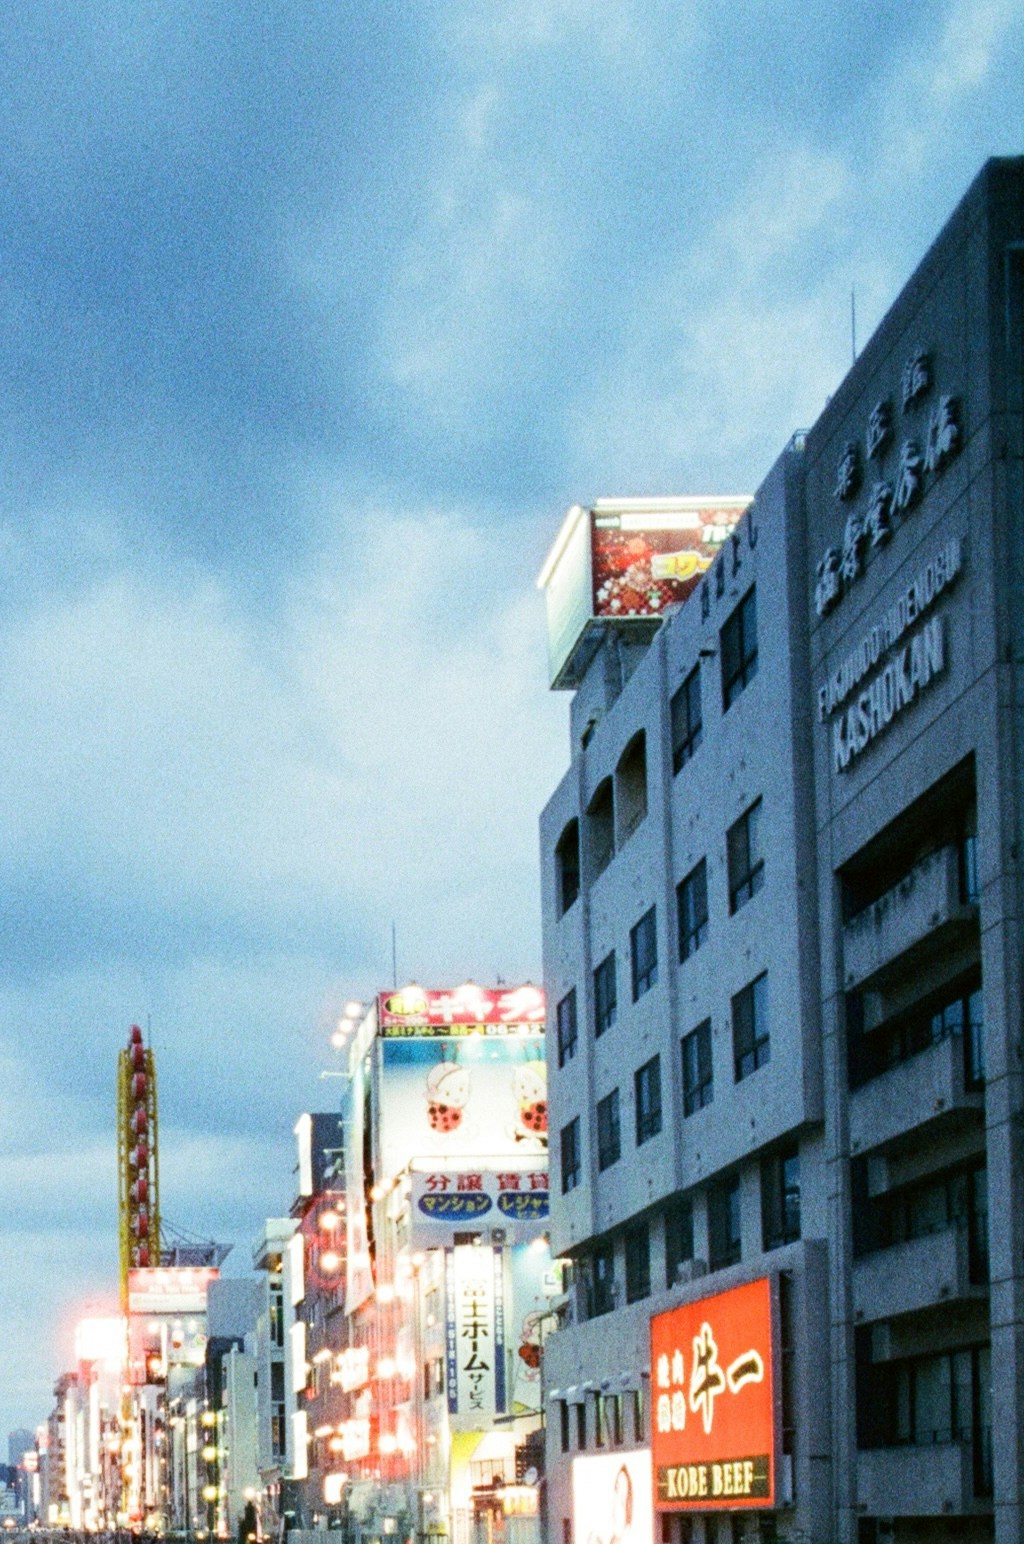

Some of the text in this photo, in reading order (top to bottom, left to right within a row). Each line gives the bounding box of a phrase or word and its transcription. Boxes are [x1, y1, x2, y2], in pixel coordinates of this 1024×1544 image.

[832, 615, 945, 774] KASHOKAN
[425, 1173, 483, 1191] 分譲
[423, 1196, 489, 1211] マンション
[689, 1321, 764, 1434] 牛一
[666, 1461, 754, 1498] KOBE BEEF
